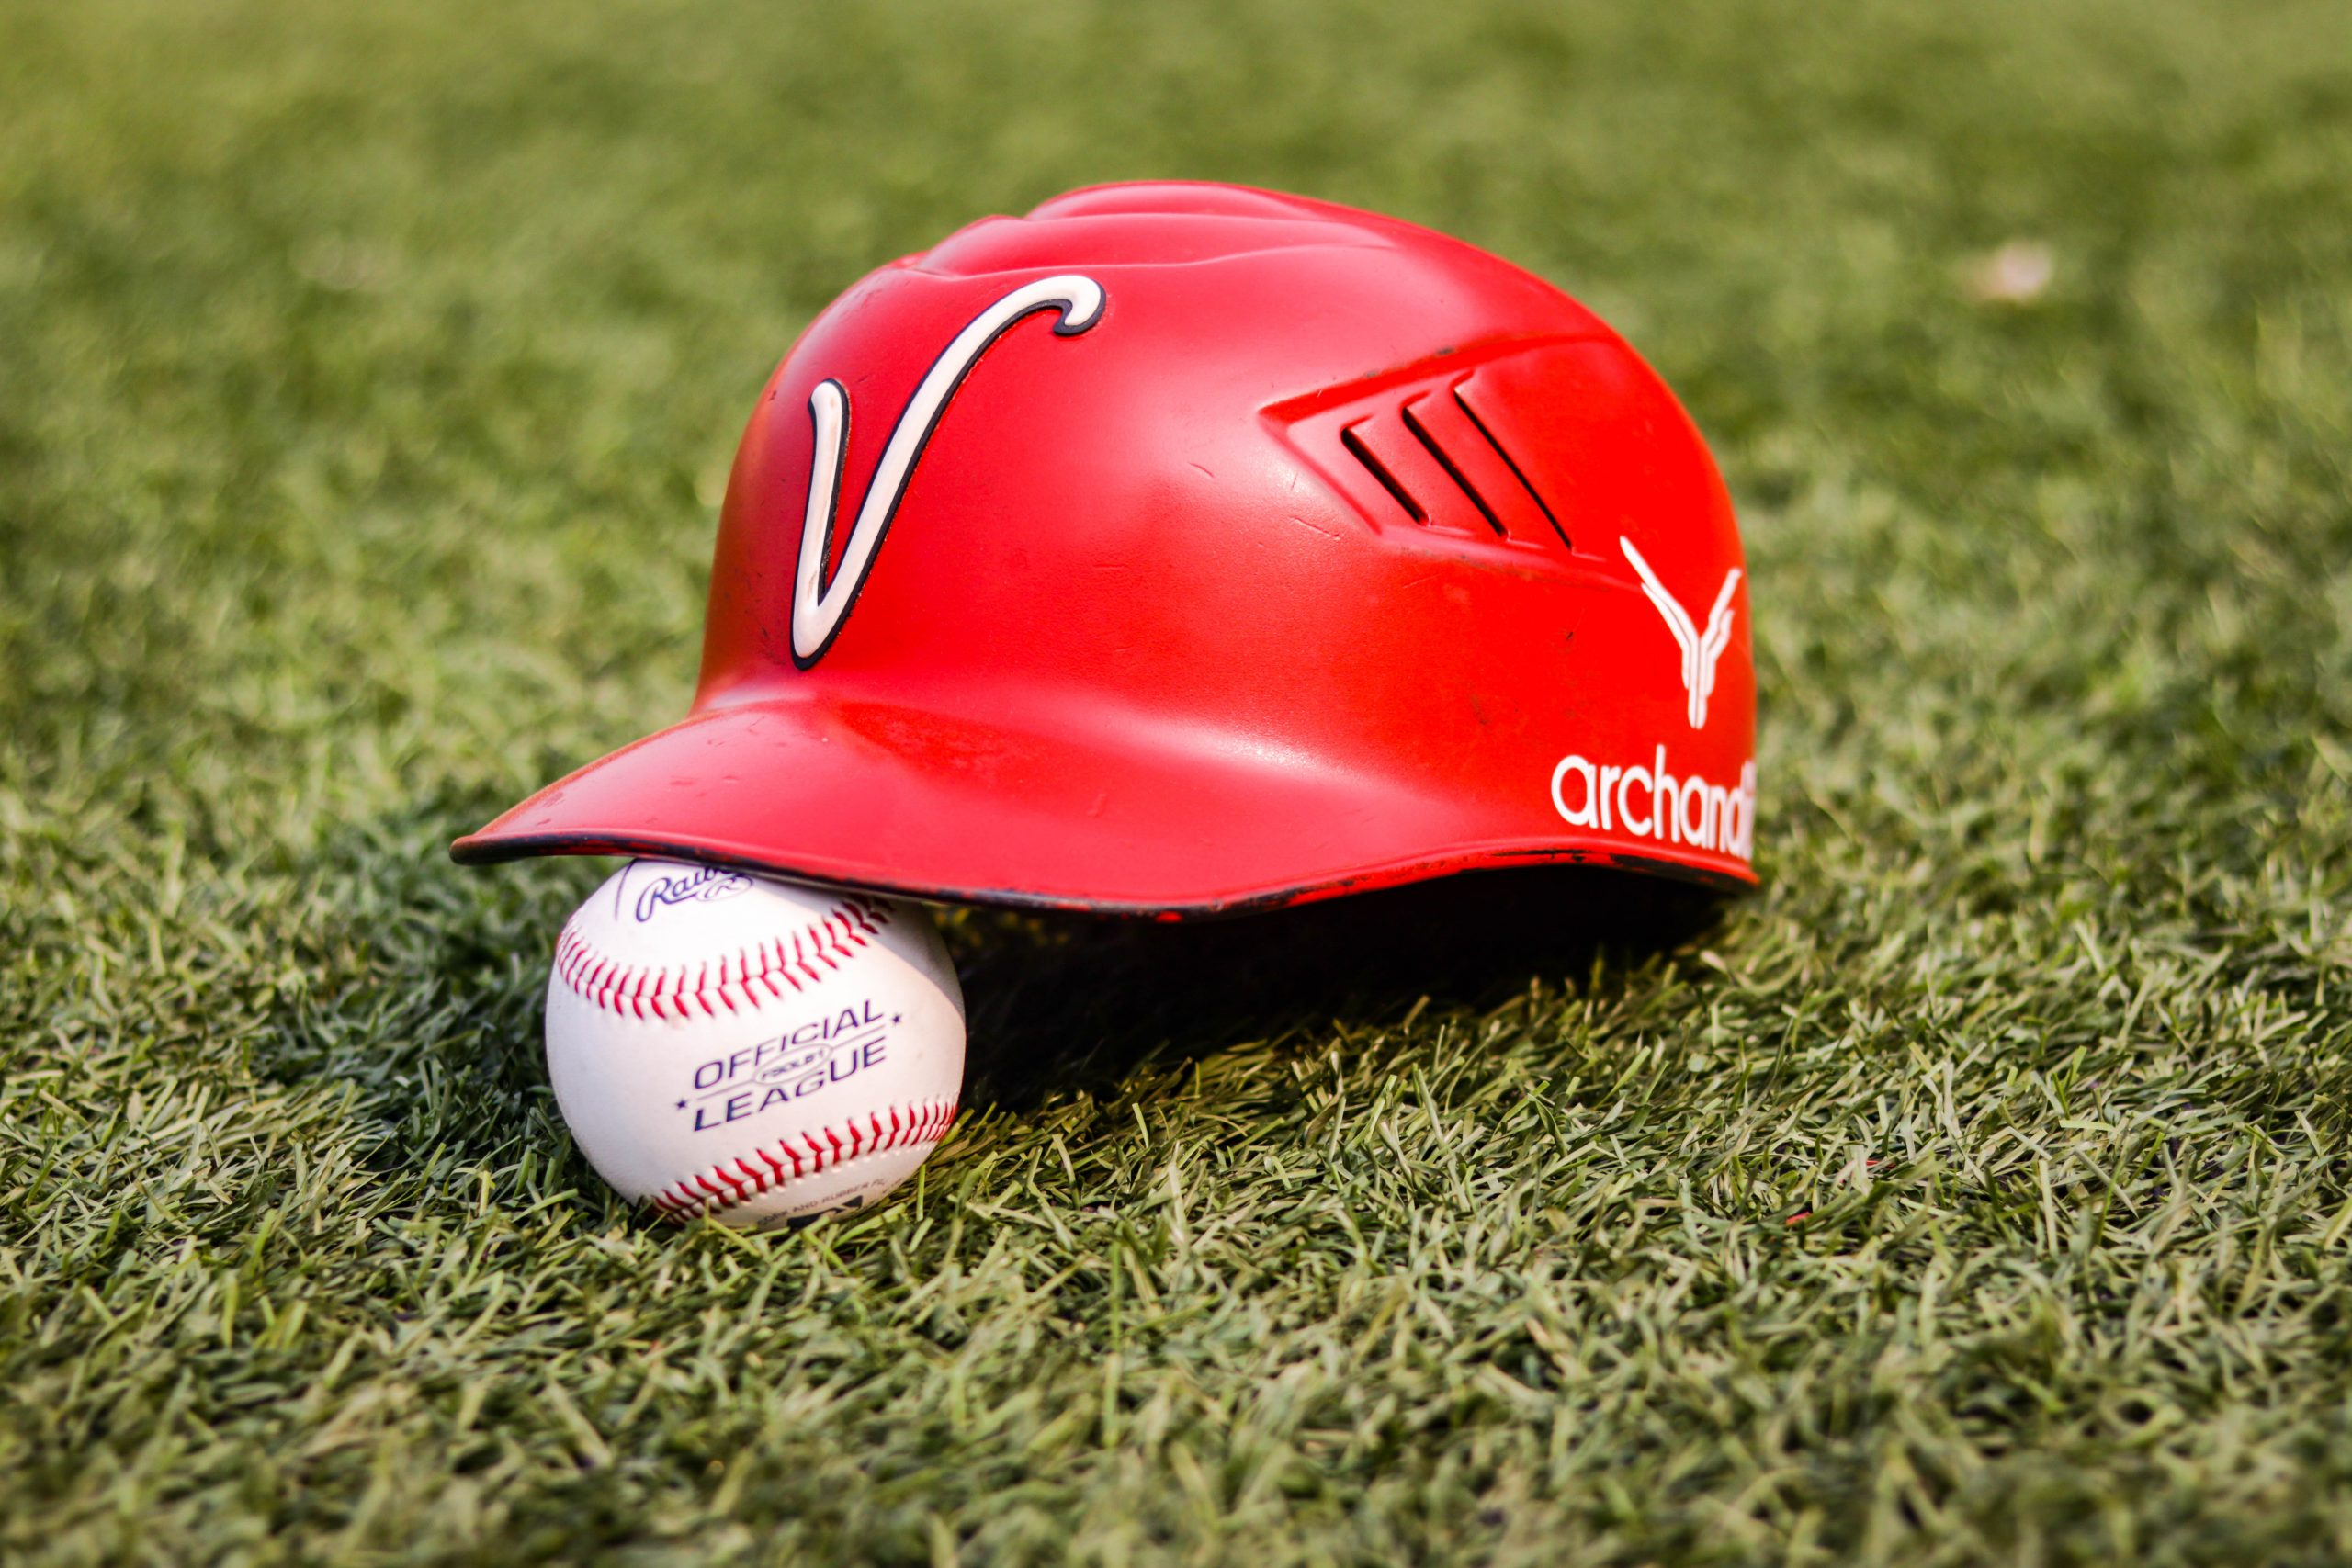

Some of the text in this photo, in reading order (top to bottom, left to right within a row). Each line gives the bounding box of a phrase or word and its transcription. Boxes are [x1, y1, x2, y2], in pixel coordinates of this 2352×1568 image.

[790, 274, 1106, 671] V
[693, 1035, 888, 1133] LEAGUE
[694, 998, 885, 1090] OFFICIAL
